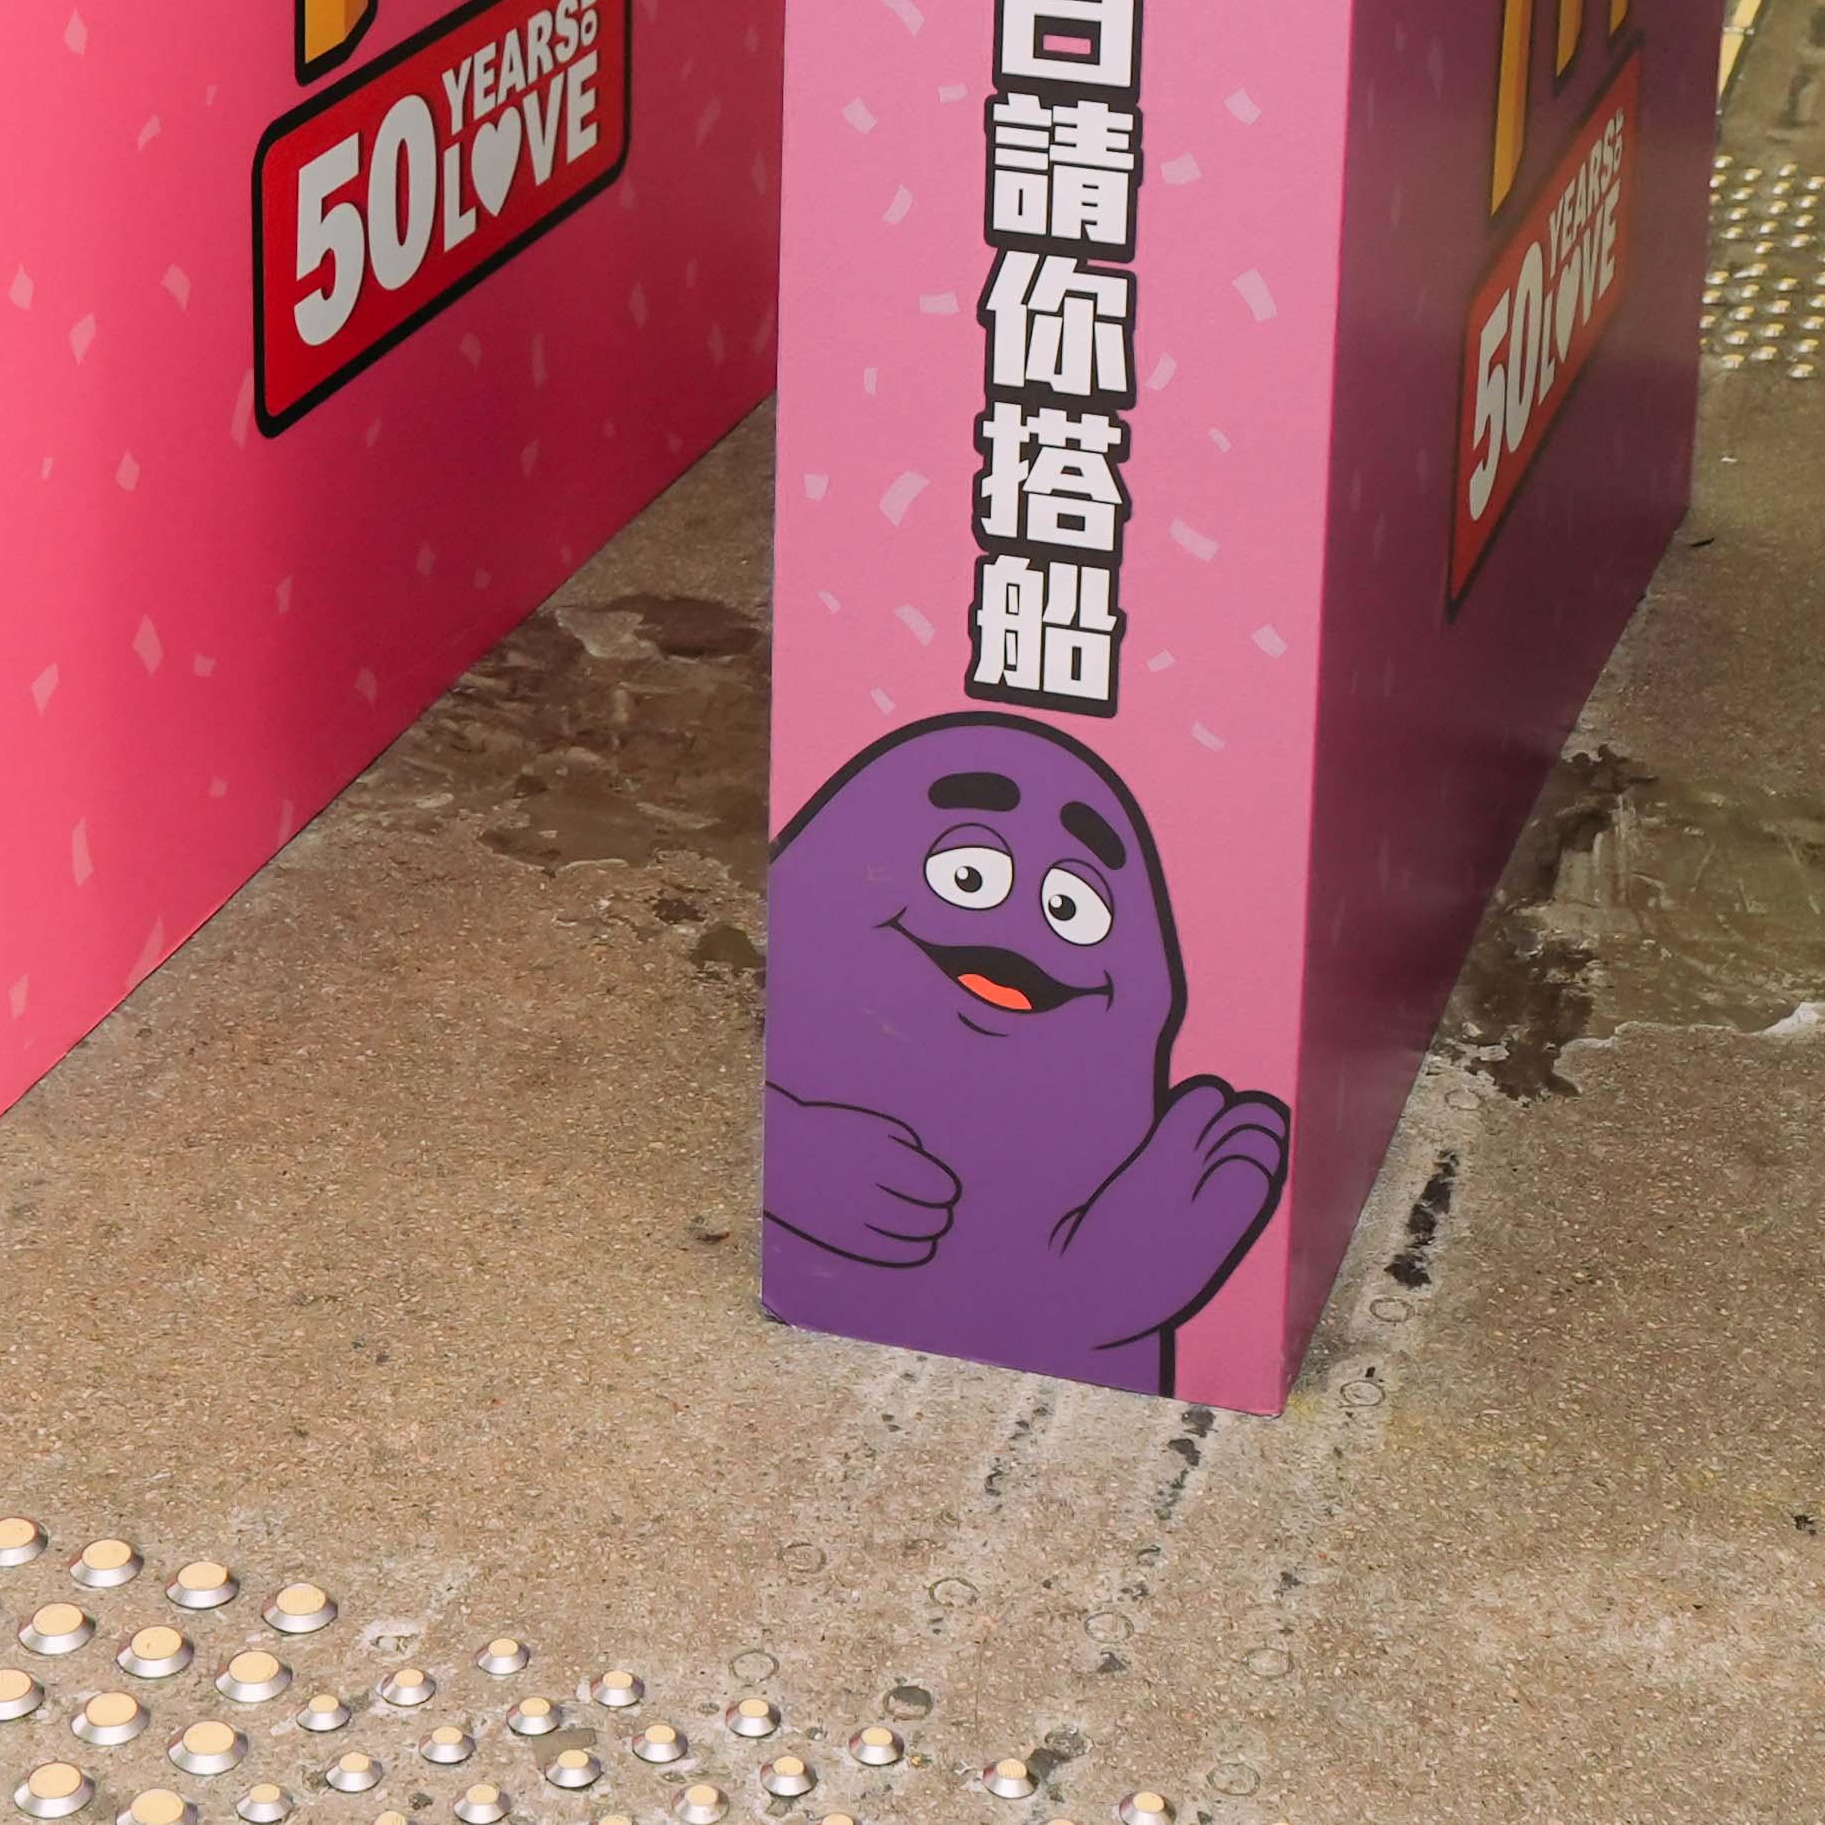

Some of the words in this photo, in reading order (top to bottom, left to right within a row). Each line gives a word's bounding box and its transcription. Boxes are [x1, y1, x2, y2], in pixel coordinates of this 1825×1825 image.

[293, 94, 437, 346] 50
[1469, 241, 1543, 521] 50
[1549, 118, 1615, 279] YEARS
[1614, 107, 1624, 171] OF
